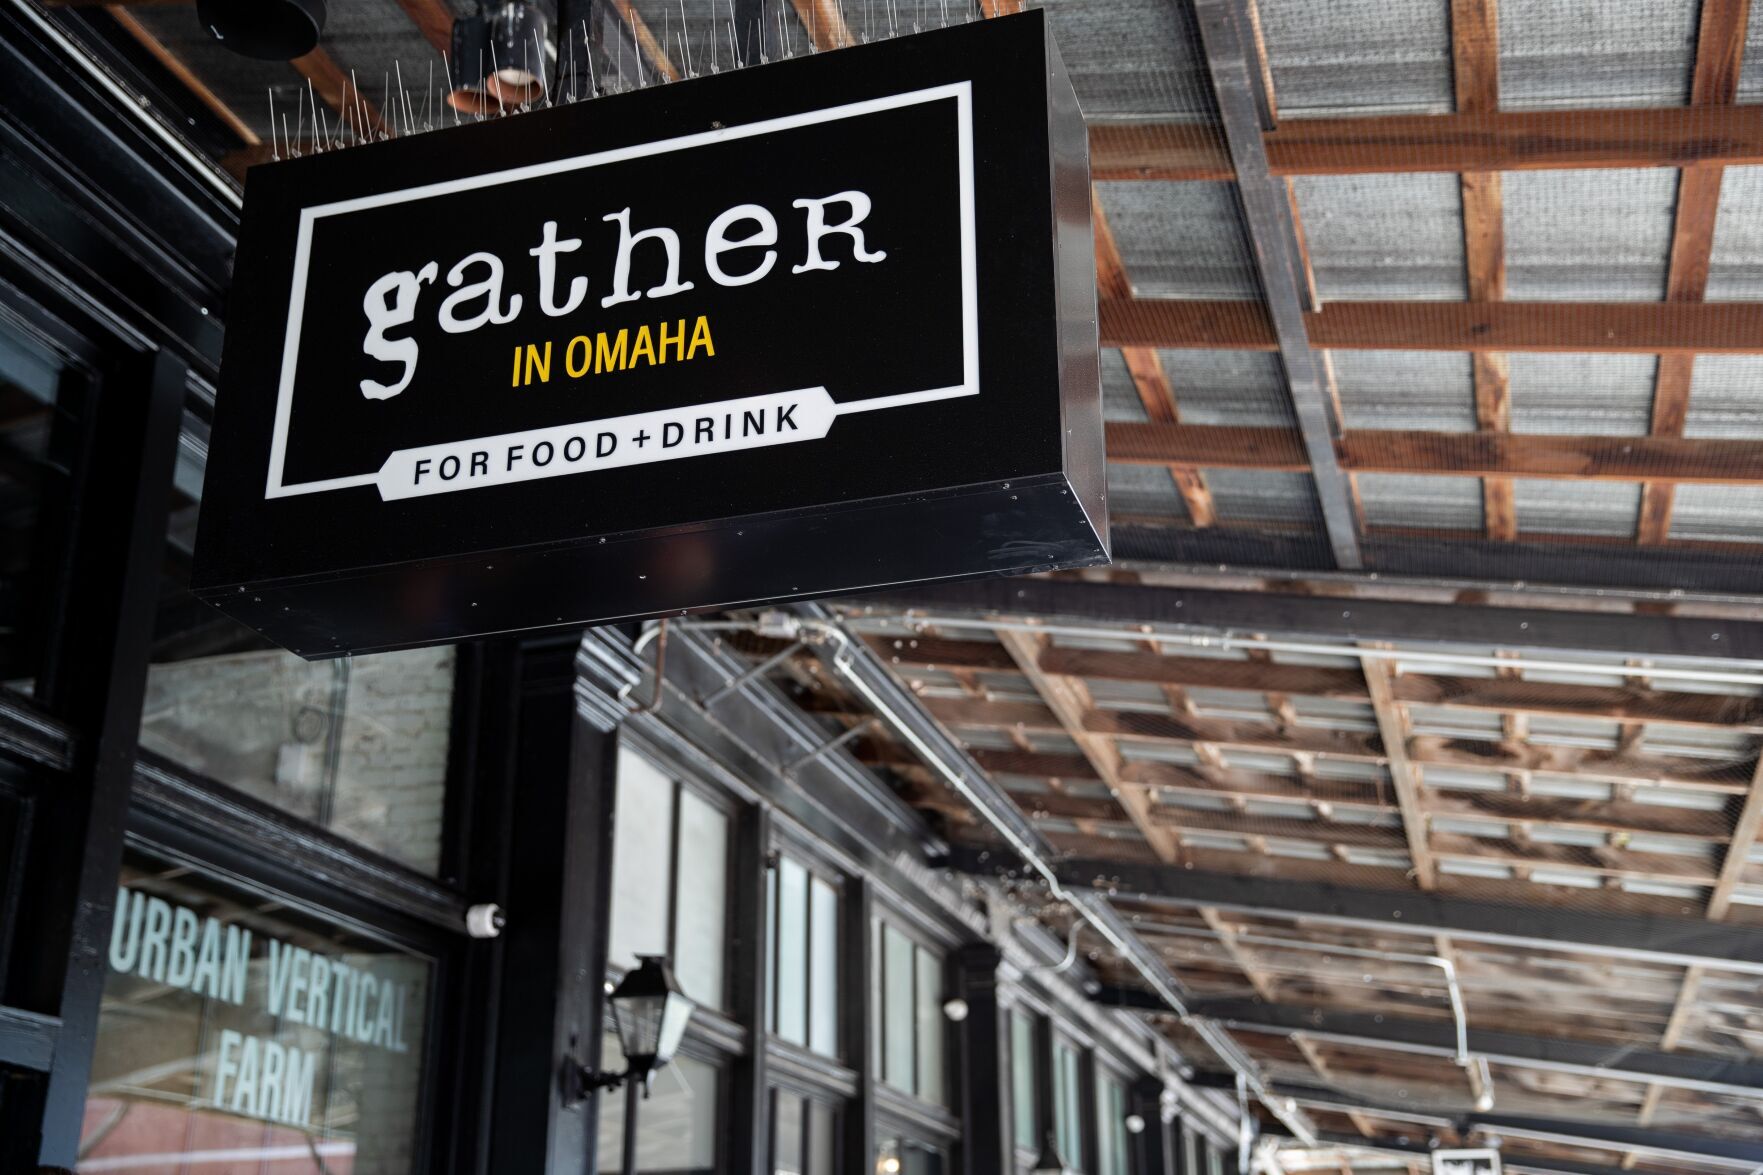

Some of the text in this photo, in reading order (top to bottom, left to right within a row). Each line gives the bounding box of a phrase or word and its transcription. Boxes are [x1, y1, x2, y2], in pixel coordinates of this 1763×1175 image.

[512, 315, 716, 388] IN OMAHA
[413, 450, 489, 486] FOR
[109, 887, 408, 1052] URBAN VERTICAL
[214, 1029, 315, 1126] FARM
